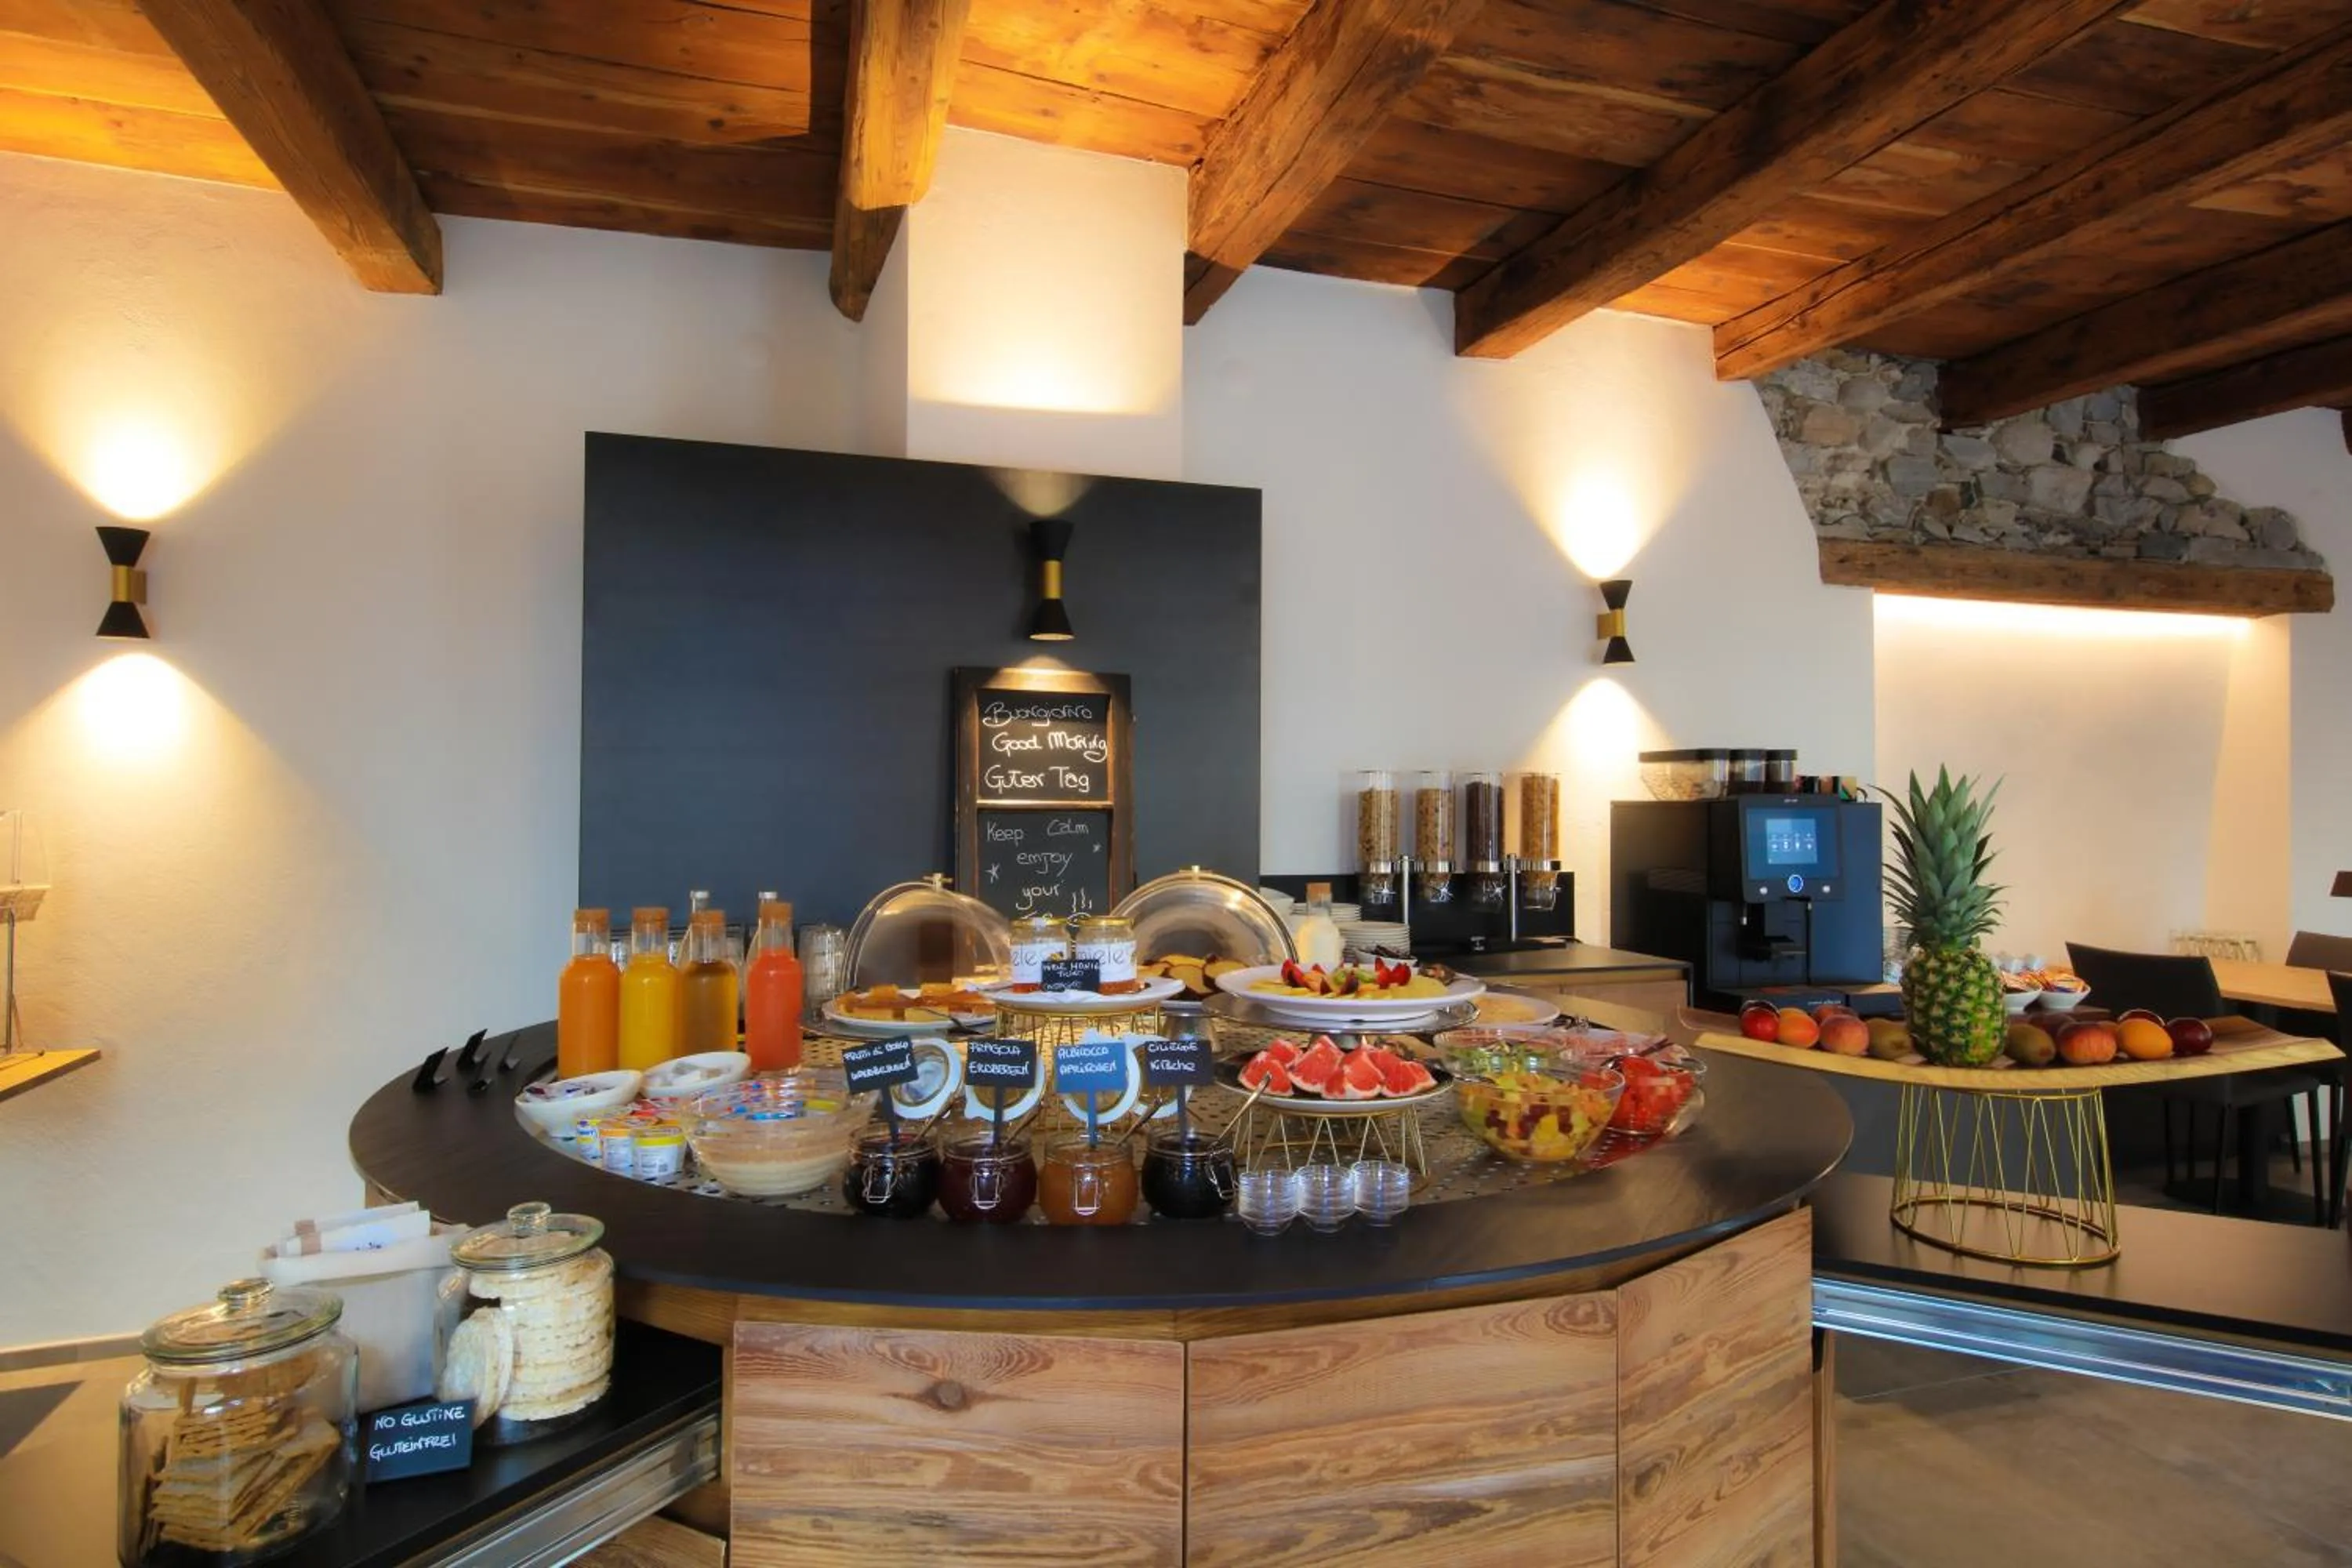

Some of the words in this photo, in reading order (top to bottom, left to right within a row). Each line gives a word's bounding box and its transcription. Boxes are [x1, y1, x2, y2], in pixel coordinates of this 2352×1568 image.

[992, 731, 1043, 757] Good
[1048, 731, 1108, 763] Morning
[984, 764, 1045, 794] Guten
[1049, 766, 1090, 793] Tag
[986, 822, 1024, 846] Keep
[1016, 852, 1073, 877] enjoy
[1015, 884, 1060, 910] your
[374, 1414, 397, 1431] NO
